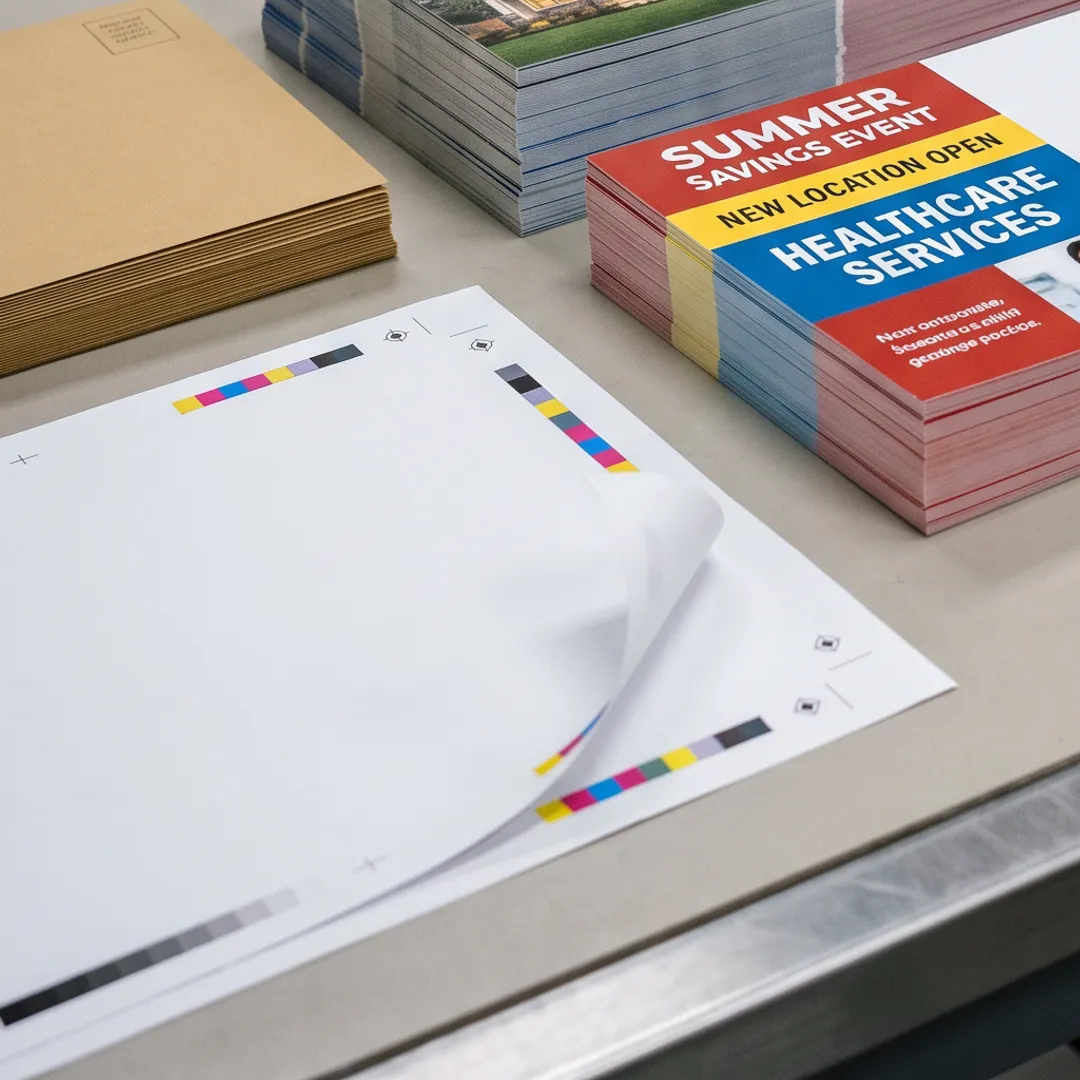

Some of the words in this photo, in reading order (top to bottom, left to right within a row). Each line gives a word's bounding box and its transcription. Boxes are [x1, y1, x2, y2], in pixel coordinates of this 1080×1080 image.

[660, 87, 911, 170] SUMMER
[686, 140, 832, 191] SAVINGS
[830, 105, 938, 149] EVENT
[715, 198, 785, 229] NEW
[786, 156, 927, 208] LOCATION
[925, 132, 1004, 164] OPEN
[769, 165, 1059, 272] HEALTHCARE
[842, 203, 1061, 285] SERVICES
